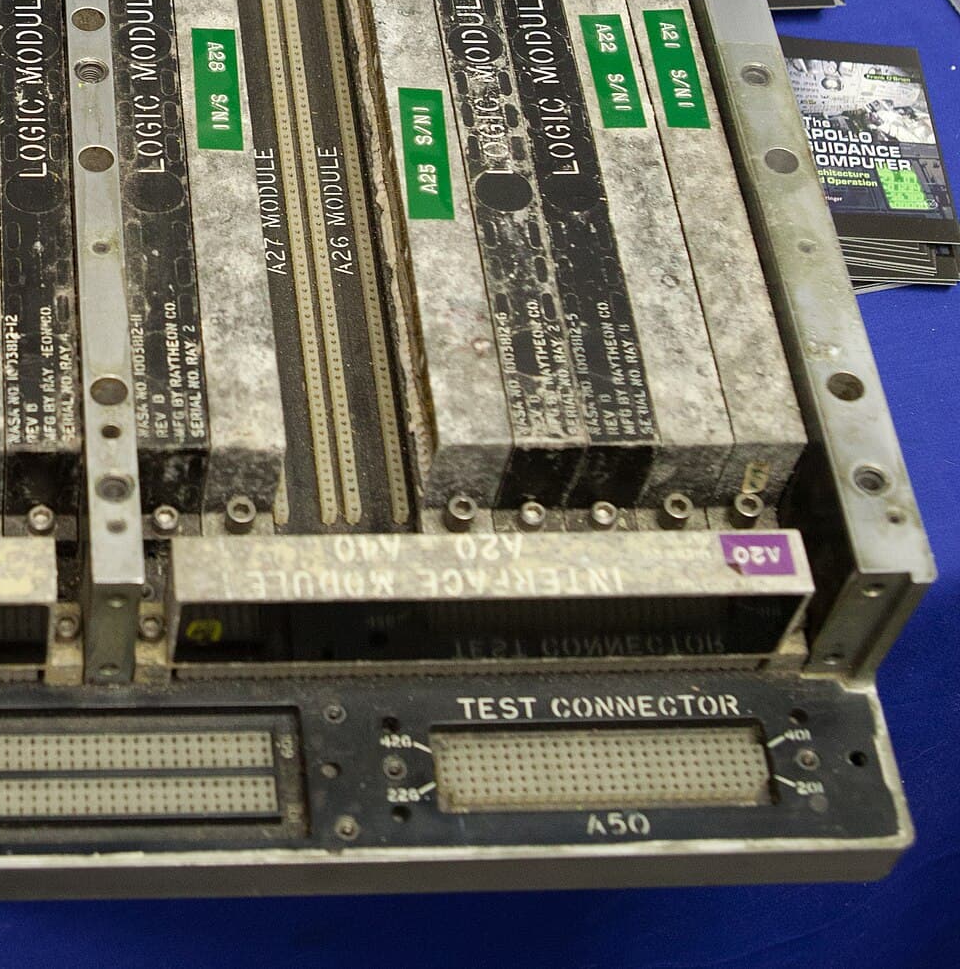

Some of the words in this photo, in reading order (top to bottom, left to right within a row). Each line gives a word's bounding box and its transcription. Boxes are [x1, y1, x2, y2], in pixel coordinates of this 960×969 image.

[658, 21, 680, 49] A21
[206, 41, 226, 72] A28
[594, 22, 617, 53] A22
[606, 72, 633, 112] S/N1
[668, 69, 695, 108] S/N1
[209, 93, 230, 130] S/N1
[411, 105, 433, 146] S/N1
[803, 117, 831, 128] The
[17, 99, 47, 178] LOGIC
[133, 94, 166, 173] LOGIC
[474, 96, 514, 175] LOGIC
[538, 97, 581, 176] LOGIC
[254, 147, 281, 228] MODULE
[317, 146, 347, 226] MODULE
[417, 164, 438, 195] A25
[827, 178, 878, 187] Operation
[264, 236, 287, 275] A27
[330, 236, 354, 275] A26
[732, 544, 781, 565] A20
[456, 696, 538, 721] TEST
[550, 693, 741, 719] CONNECTOR
[587, 812, 653, 835] A50
